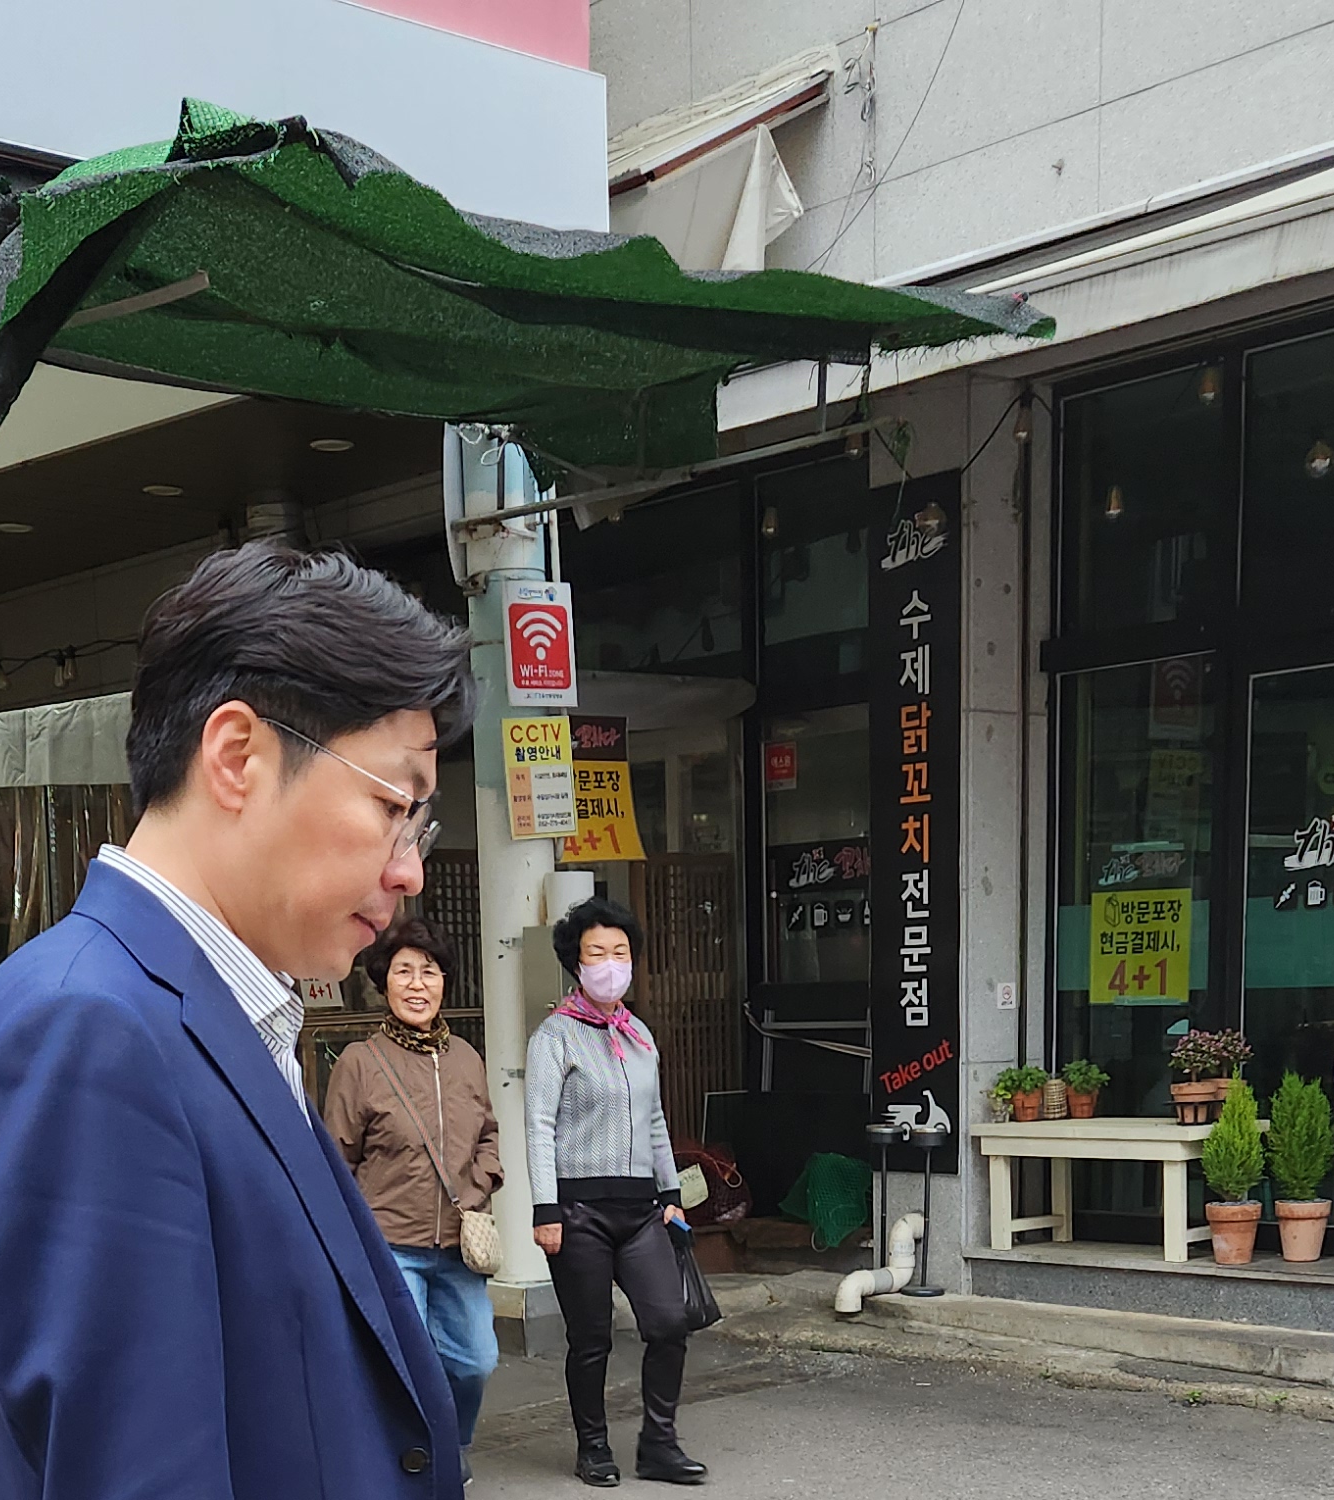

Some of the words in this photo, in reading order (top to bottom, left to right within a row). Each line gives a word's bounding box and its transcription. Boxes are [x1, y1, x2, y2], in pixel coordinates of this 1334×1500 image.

[520, 664, 548, 678] Wi-Fi
[509, 723, 562, 744] CCTV
[572, 770, 621, 792] 문포장
[1121, 900, 1182, 924] 방문포장
[1108, 958, 1168, 996] 4+1
[309, 982, 333, 1000] 4+1
[879, 1056, 921, 1095] Take
[923, 1039, 954, 1072] out
